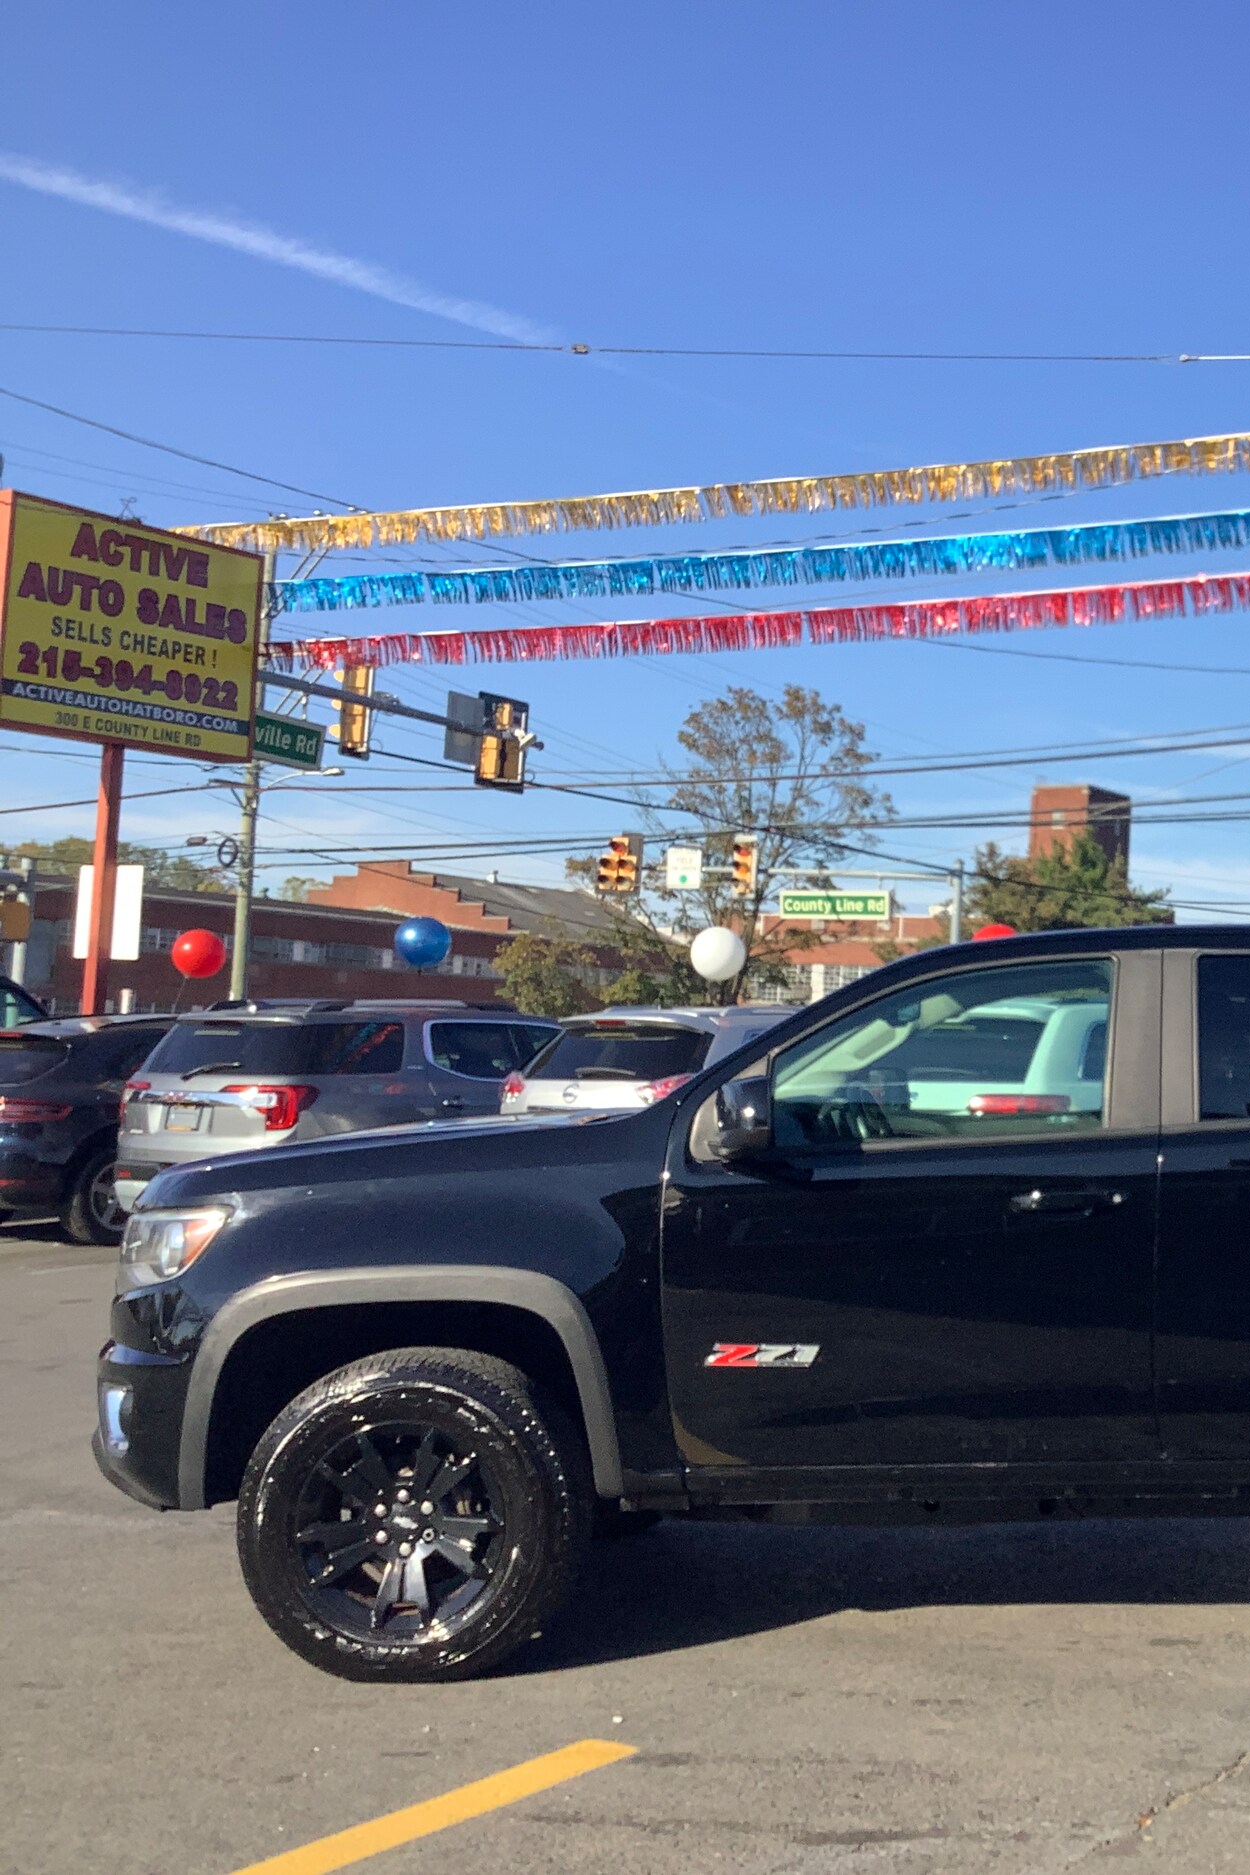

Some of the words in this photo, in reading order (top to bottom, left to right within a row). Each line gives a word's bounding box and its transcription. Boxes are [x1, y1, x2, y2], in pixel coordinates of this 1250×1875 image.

[70, 523, 209, 588] ACTIVE
[17, 562, 125, 617] AUTO
[136, 588, 247, 644] SALES
[51, 616, 112, 648] SELLS
[12, 682, 238, 733] ACTIVEAUTOHATBORO.COM
[83, 714, 91, 729] E
[95, 717, 149, 739] COUNTY
[153, 727, 181, 743] LINE
[185, 732, 202, 747] RD
[255, 724, 291, 750] ville
[296, 734, 317, 755] Rd
[784, 898, 831, 914] County
[835, 898, 864, 912] Line
[867, 898, 884, 912] Rd
[704, 1343, 820, 1367] Z71
